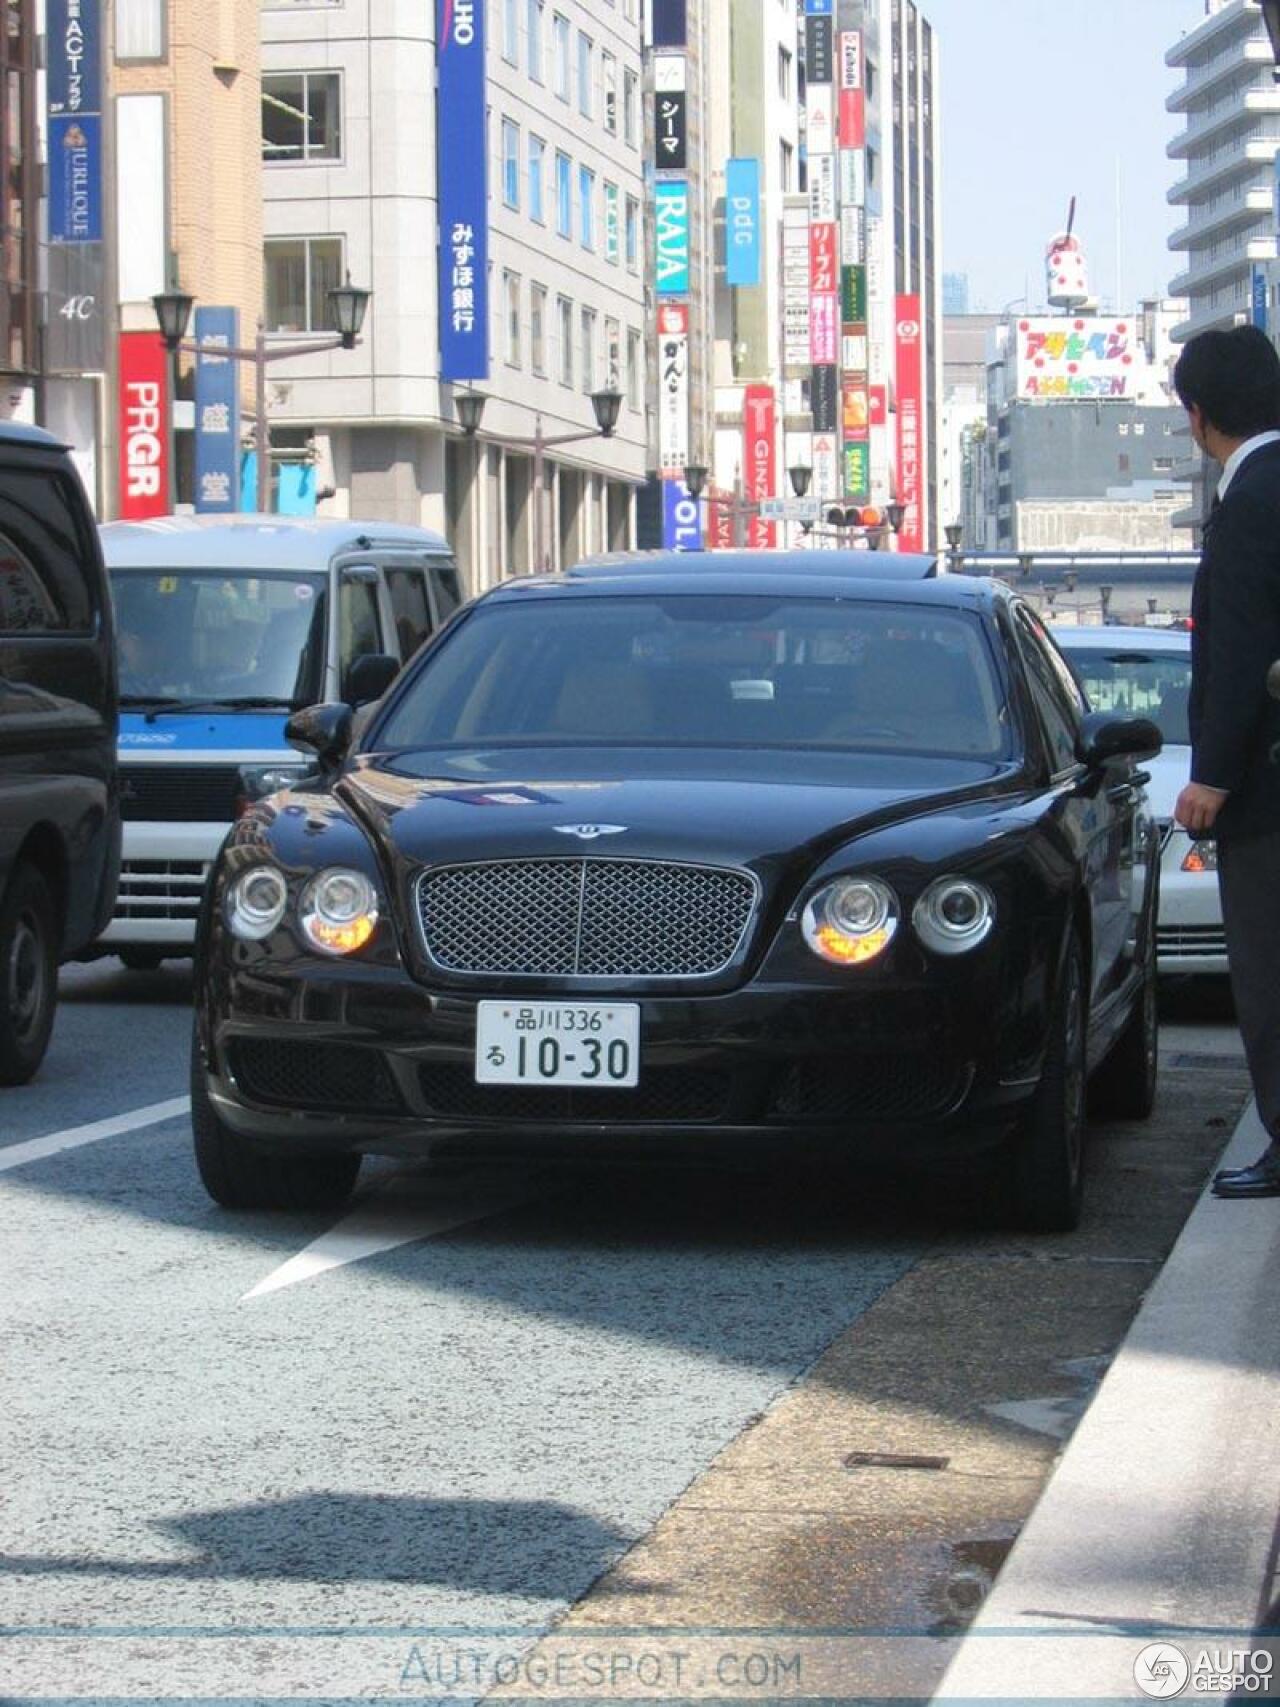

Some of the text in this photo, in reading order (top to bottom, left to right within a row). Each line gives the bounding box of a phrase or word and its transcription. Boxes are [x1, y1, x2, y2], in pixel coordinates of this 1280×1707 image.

[661, 101, 679, 153] シーマ
[452, 223, 474, 332] みずほ銀行
[656, 194, 688, 281] RAJA
[127, 381, 161, 497] PRGR
[486, 1036, 629, 1079] る 10-30
